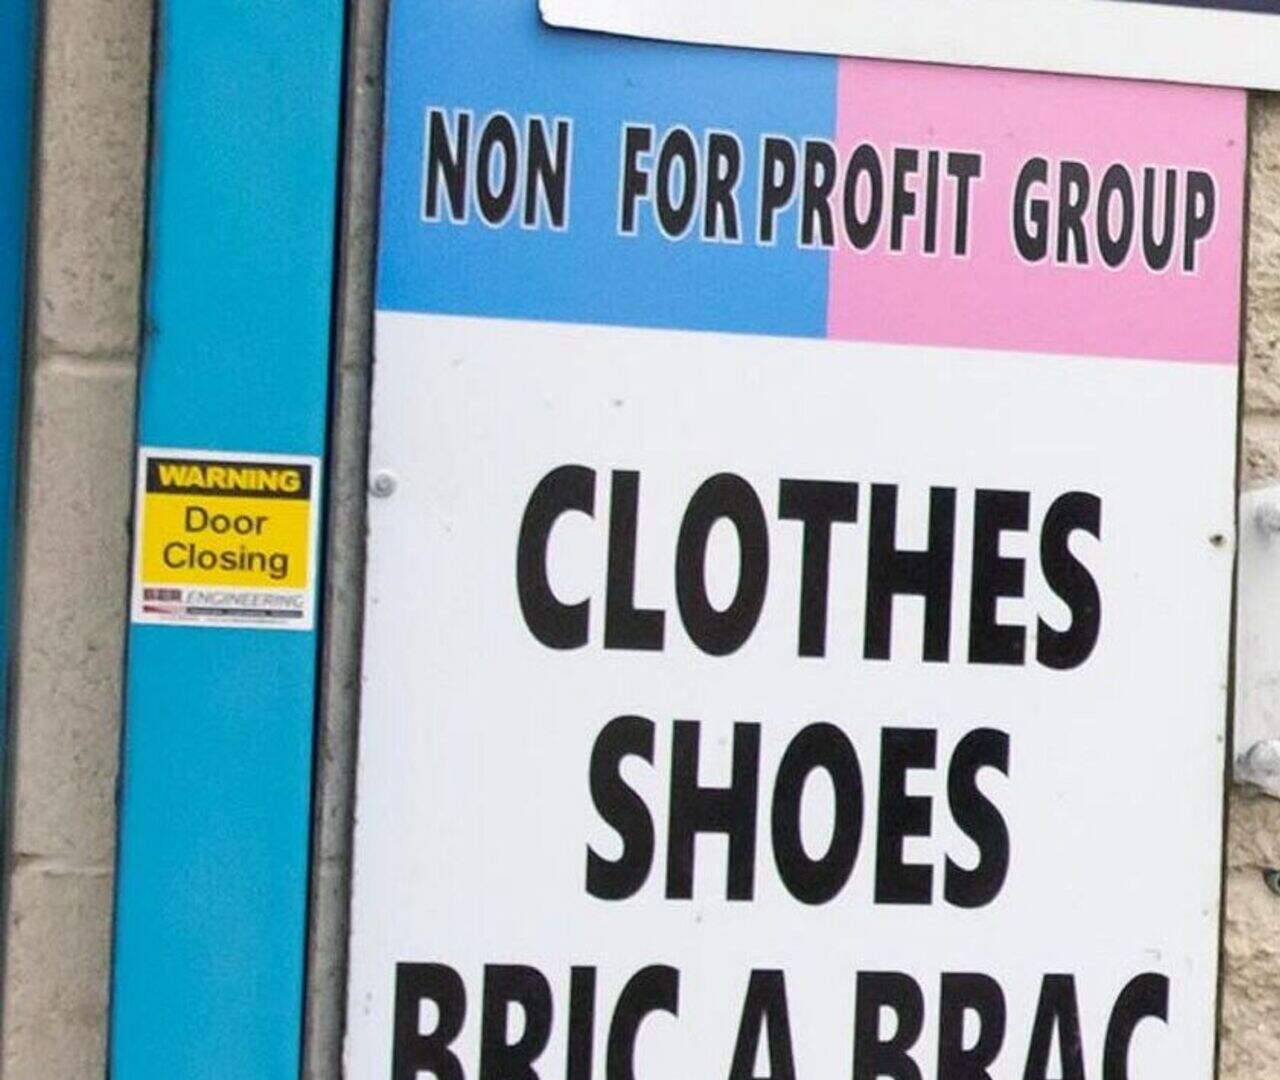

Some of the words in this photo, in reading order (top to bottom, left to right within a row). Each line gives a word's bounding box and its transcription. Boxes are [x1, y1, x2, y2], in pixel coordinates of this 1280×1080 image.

[423, 109, 570, 229] NON
[620, 125, 742, 241] FOR
[758, 136, 982, 257] PROFIT
[1011, 156, 1217, 273] GROUP
[158, 463, 302, 493] WARNING
[184, 505, 269, 535] Door
[162, 541, 289, 580] Closing
[515, 463, 1102, 671] CLOTHES
[584, 714, 1011, 910] SHOES
